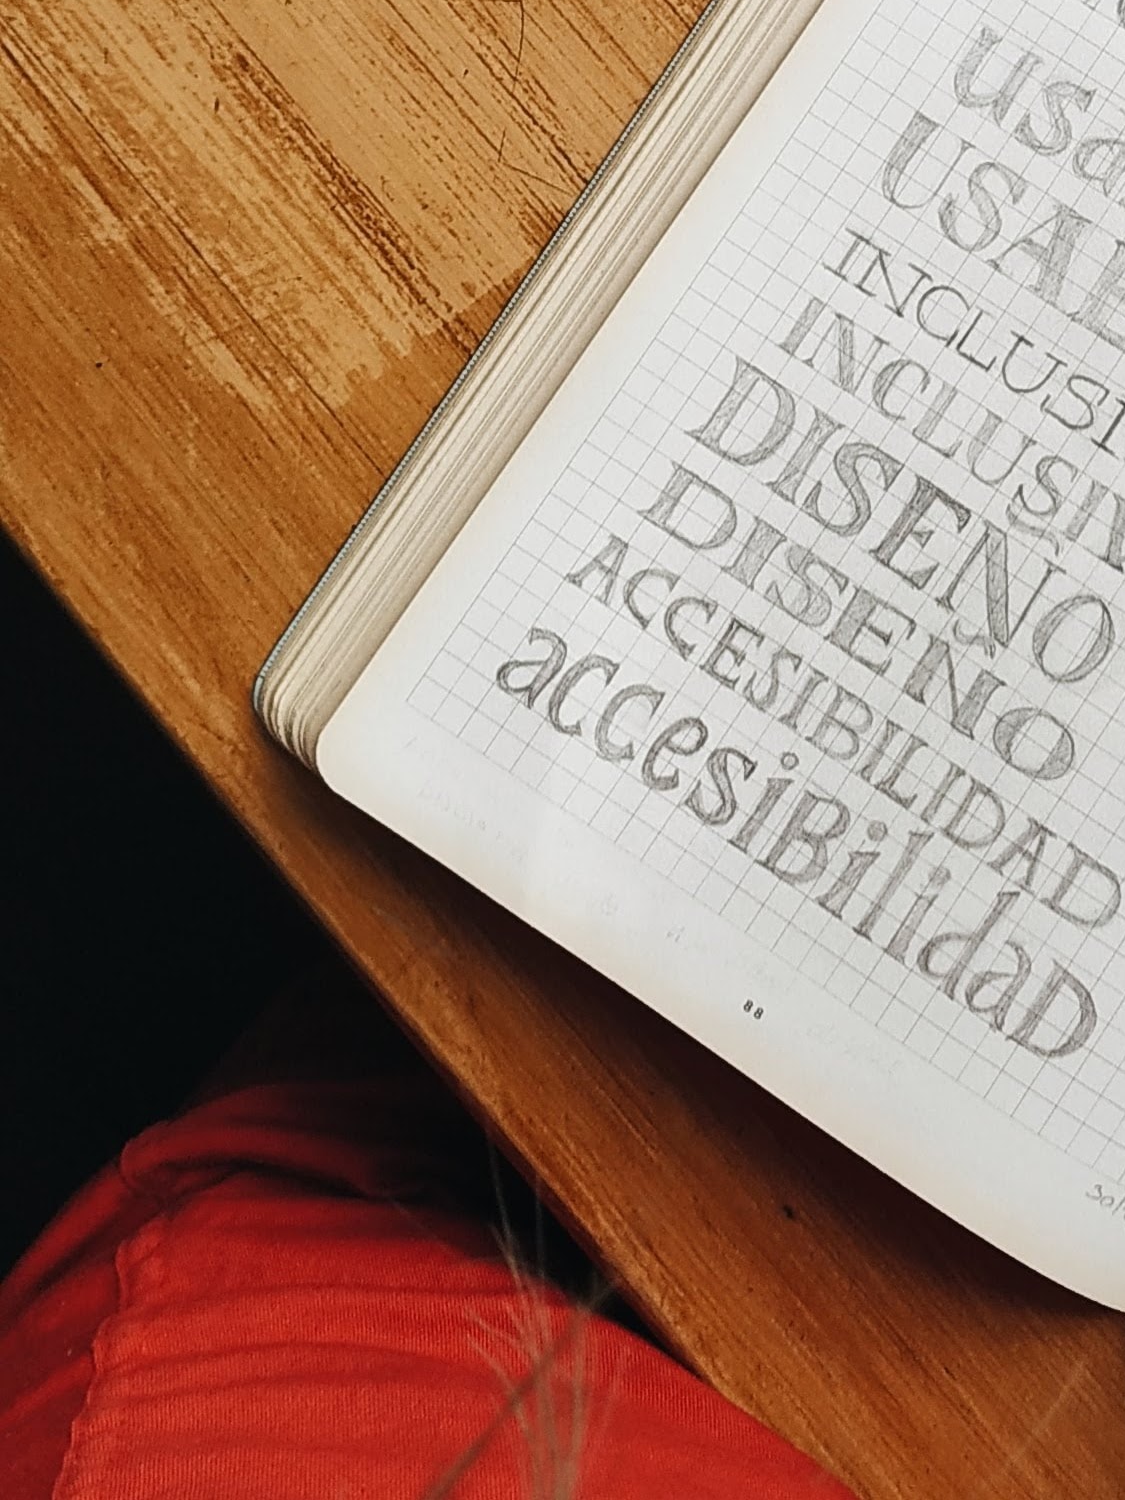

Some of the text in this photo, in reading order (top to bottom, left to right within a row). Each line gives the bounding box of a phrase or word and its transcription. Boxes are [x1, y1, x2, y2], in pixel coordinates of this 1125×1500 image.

[639, 461, 1076, 781] DISEÑO
[686, 355, 1116, 684] DISEÑO
[566, 534, 1122, 929] ACCESIBILIDAD
[743, 999, 764, 1020] 88
